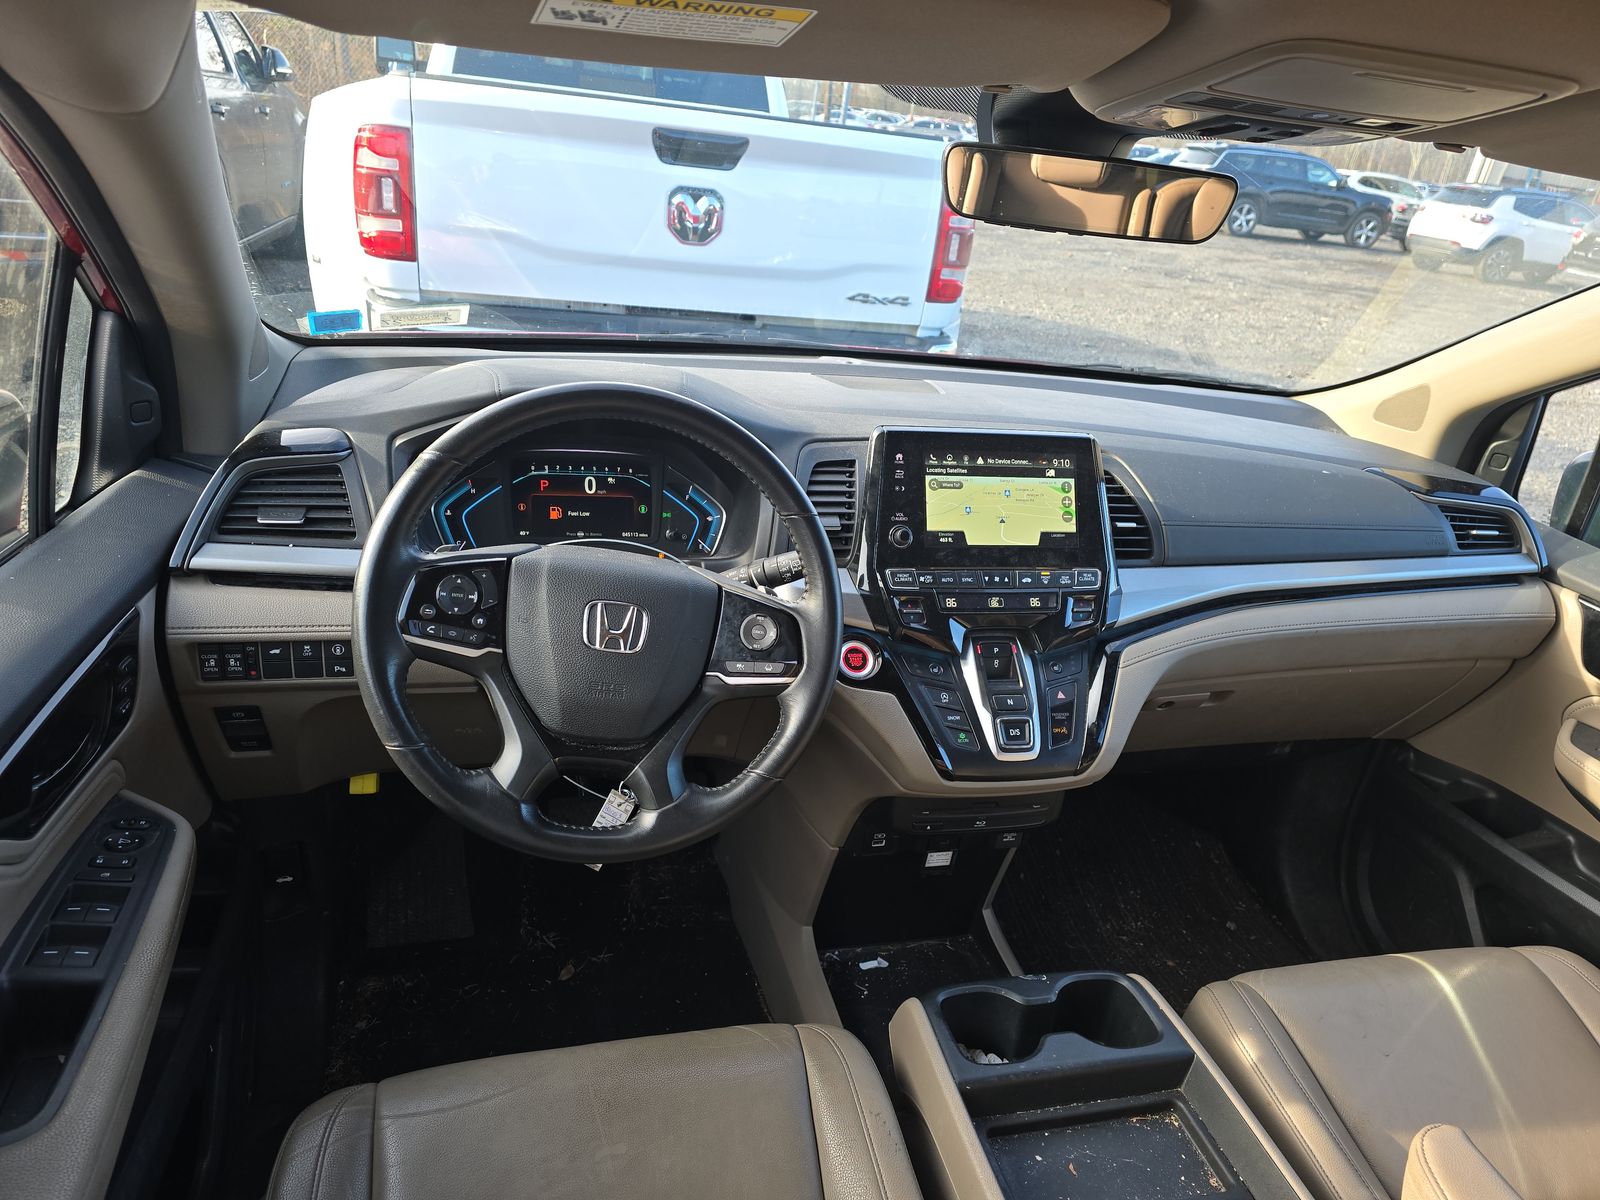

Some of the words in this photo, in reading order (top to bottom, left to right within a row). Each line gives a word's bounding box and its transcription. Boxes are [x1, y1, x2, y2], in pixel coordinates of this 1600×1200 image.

[635, 0, 776, 17] WARNING
[646, 8, 718, 20] ADVANCED
[742, 17, 777, 25] BAGS
[1052, 458, 1070, 467] 9:10
[540, 480, 549, 491] P
[584, 476, 597, 494] 0
[945, 598, 957, 608] 86
[1009, 728, 1021, 736] D/S
